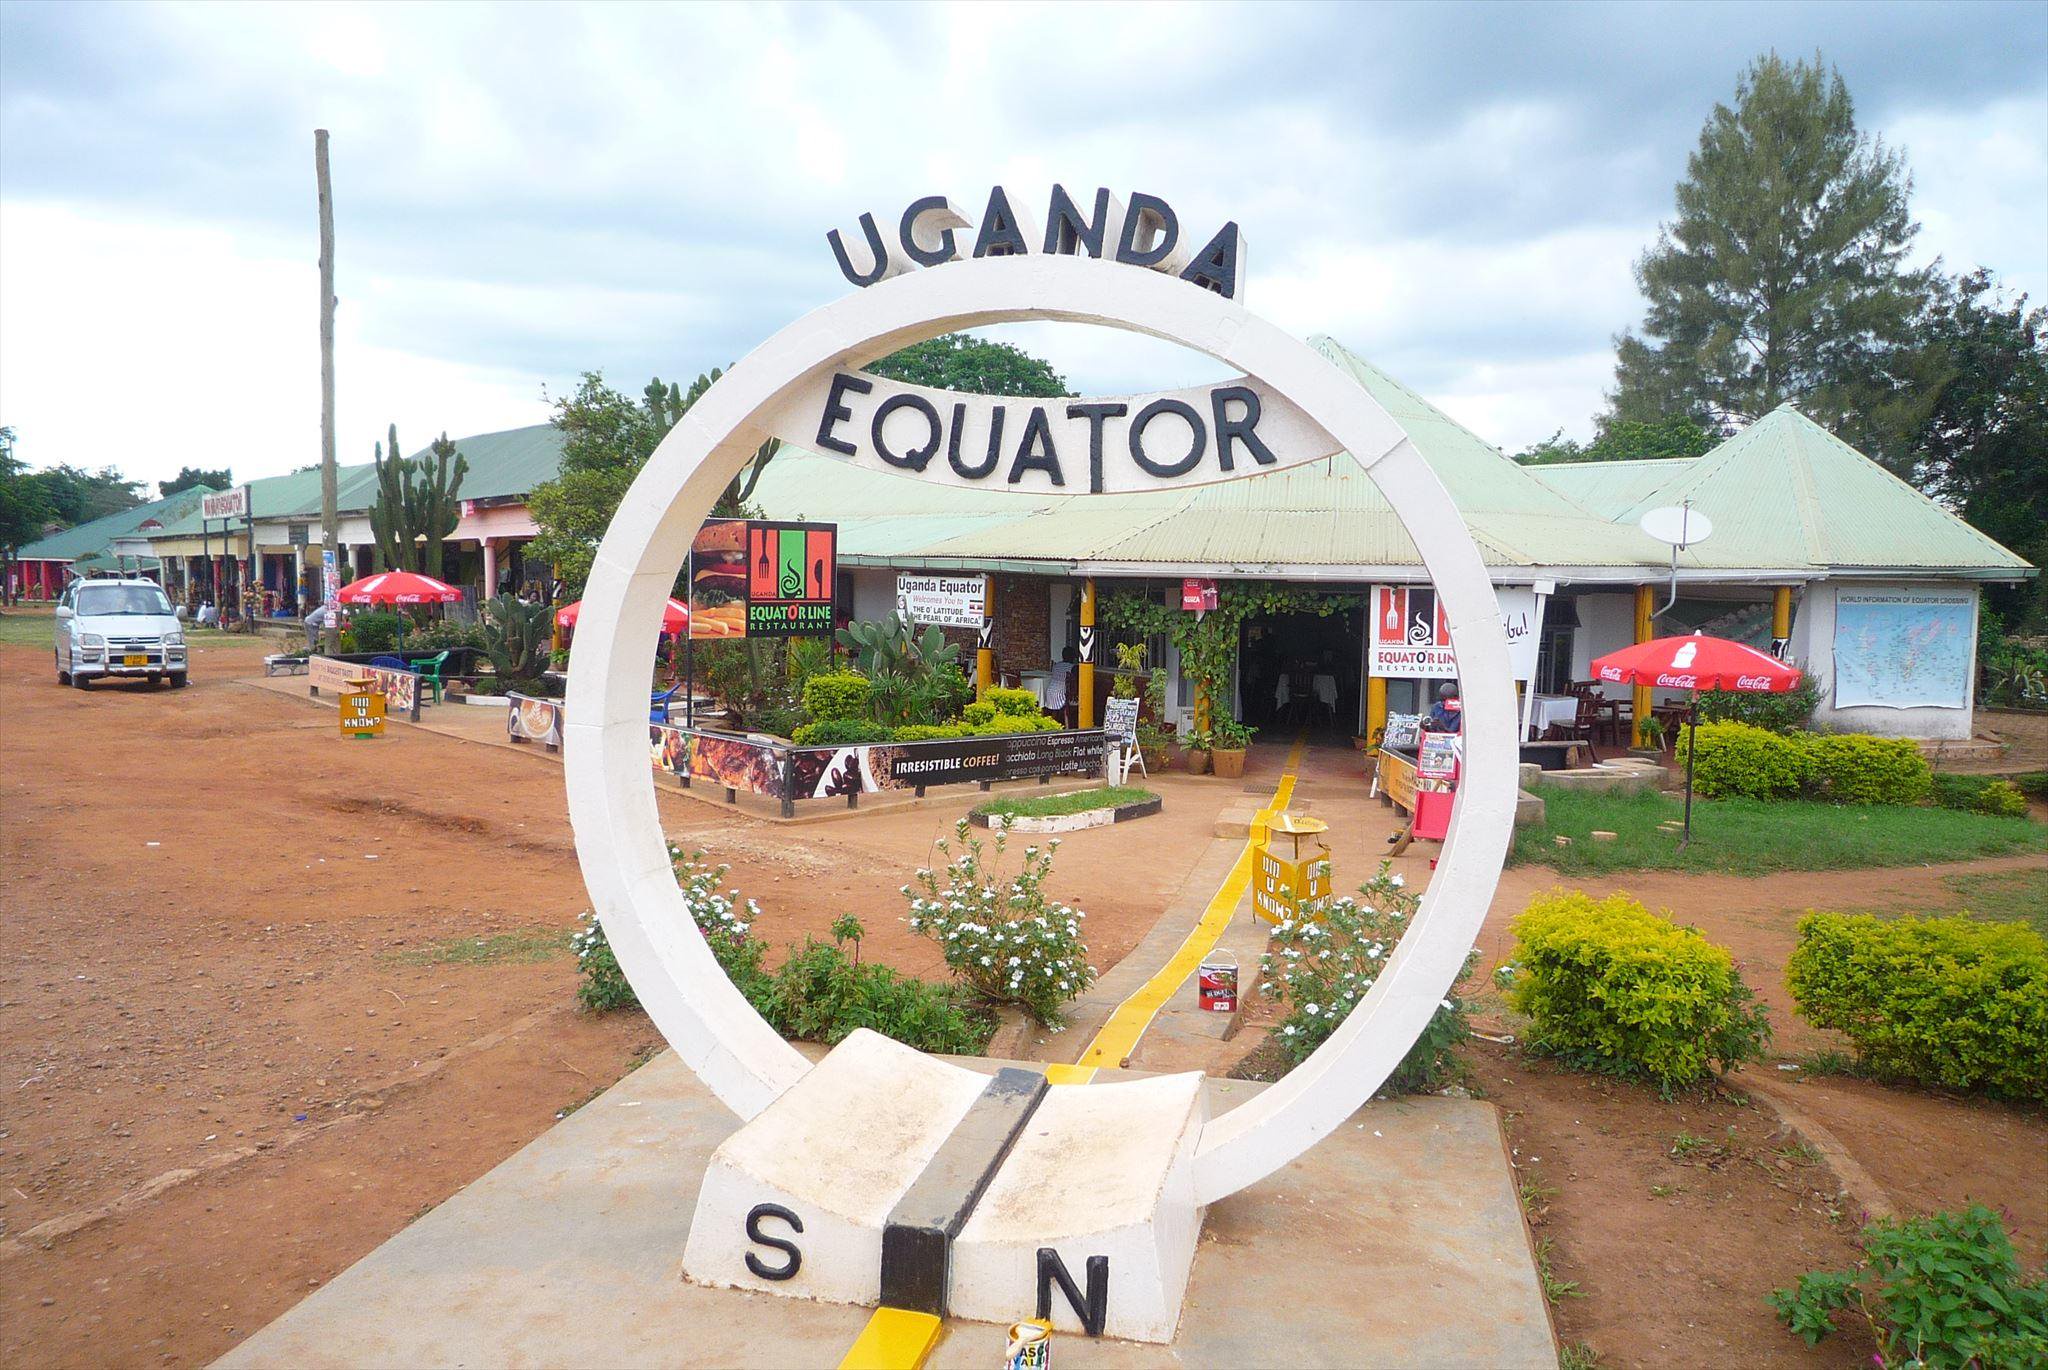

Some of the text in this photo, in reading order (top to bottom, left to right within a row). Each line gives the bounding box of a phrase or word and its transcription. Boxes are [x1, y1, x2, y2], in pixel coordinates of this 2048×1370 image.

[826, 183, 1240, 299] UGANDA
[816, 373, 1277, 494] EQUATOR
[898, 577, 983, 596] Uganda Equator
[912, 595, 942, 603] Welcomes
[944, 597, 956, 605] You
[1840, 596, 1861, 604] WORLD
[1862, 596, 1901, 604] INFORMATION
[1911, 597, 1939, 605] EQUATOR
[1940, 597, 1969, 605] CROSSING
[807, 606, 831, 620] LINE
[913, 605, 924, 613] THE
[933, 607, 964, 616] LATITUDE
[750, 621, 831, 630] RESTAURANT
[923, 614, 942, 623] PEARL
[1438, 652, 1455, 665] LIN
[1377, 664, 1453, 673] RESTAURAN
[357, 708, 367, 717] U
[344, 717, 381, 728] KNOW?
[1007, 736, 1047, 750] appuccino
[1047, 735, 1075, 748] Espresso
[1006, 745, 1104, 762] acchiato Long Black Flat white
[896, 753, 1000, 774] IRRESISTIBLE COFFEE!
[1060, 760, 1079, 771] Latte
[1266, 876, 1275, 893] U
[1310, 879, 1318, 897] U
[1257, 888, 1292, 920] KNOW?
[745, 1202, 804, 1281] S
[1036, 1248, 1109, 1337] N
